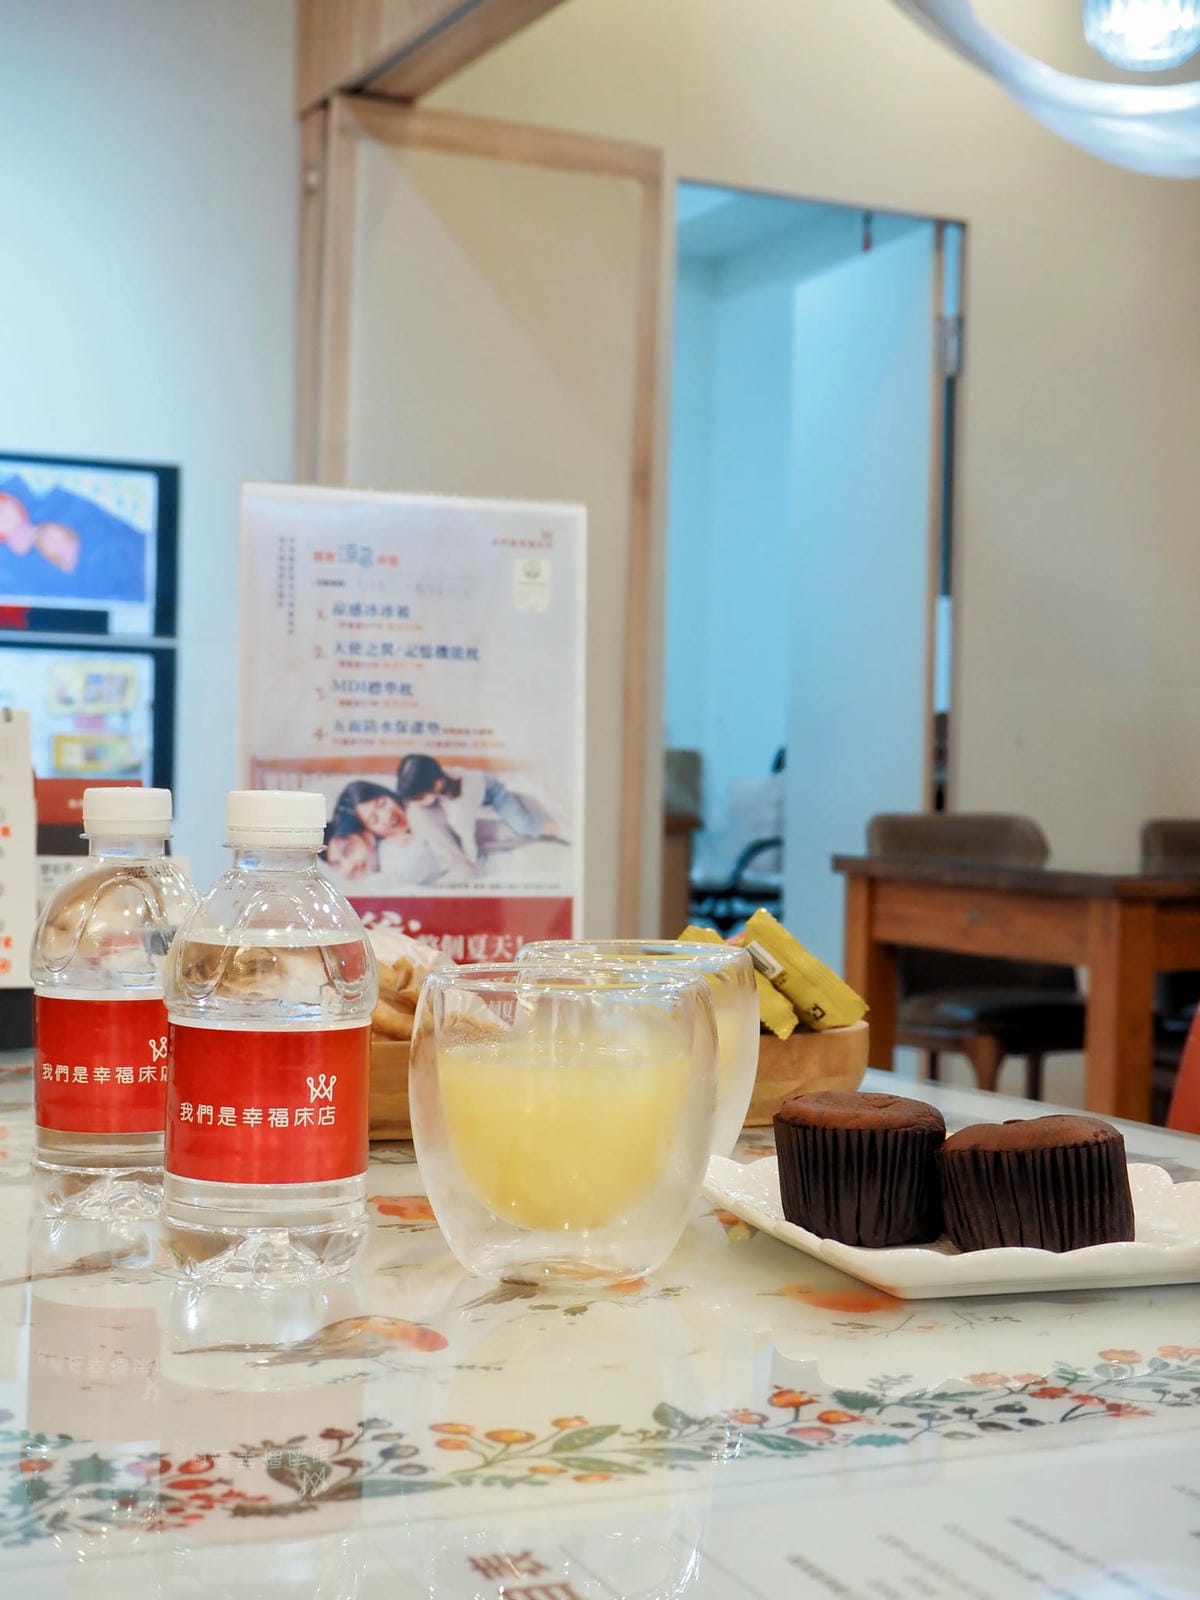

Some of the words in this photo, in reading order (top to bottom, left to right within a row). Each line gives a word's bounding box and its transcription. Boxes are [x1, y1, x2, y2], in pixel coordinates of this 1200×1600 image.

[179, 1101, 337, 1129] 我們是幸福床店
